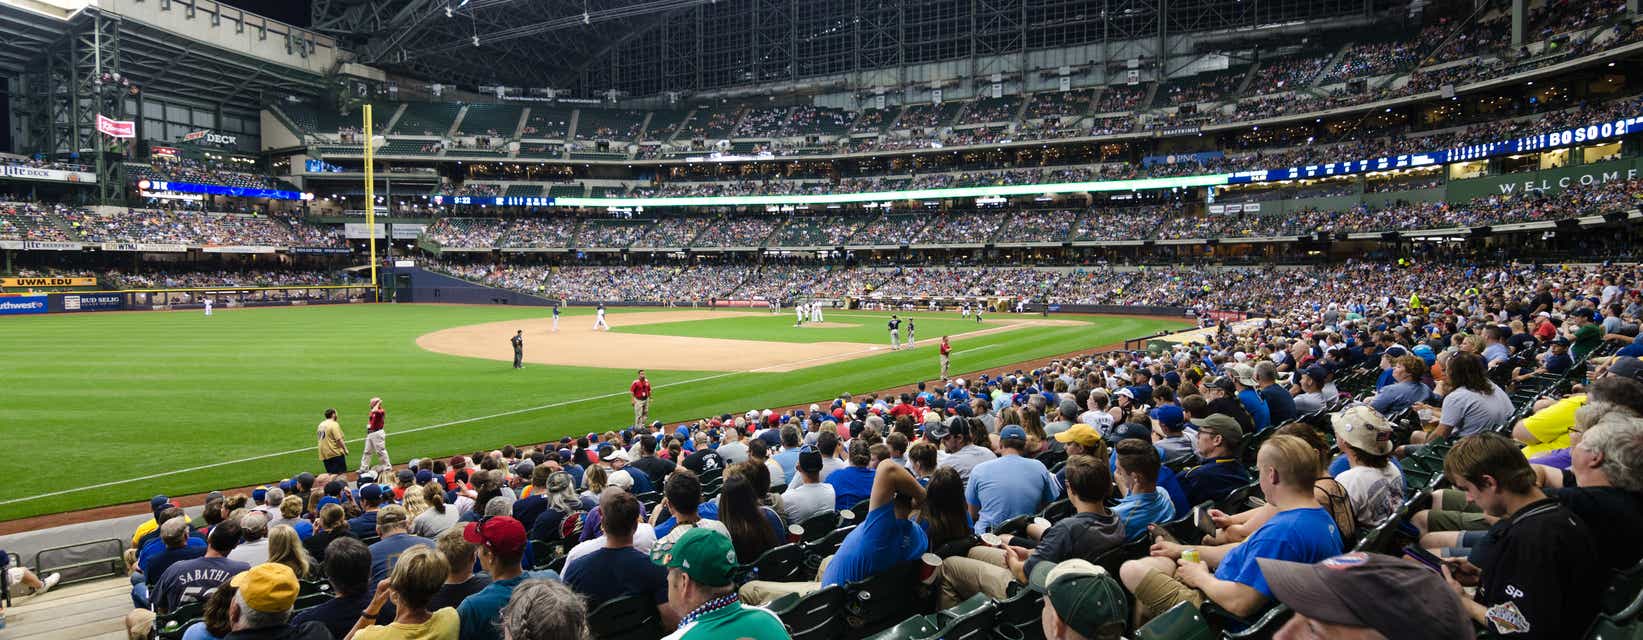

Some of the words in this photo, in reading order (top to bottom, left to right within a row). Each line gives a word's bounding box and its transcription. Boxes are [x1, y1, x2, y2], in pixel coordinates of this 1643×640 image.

[206, 133, 236, 144] DECK
[1499, 168, 1638, 194] WELCOME
[17, 278, 72, 286] UWM.EDU
[0, 301, 37, 309] uthwest
[178, 568, 230, 585] SABATHI
[1505, 584, 1524, 598] SP
